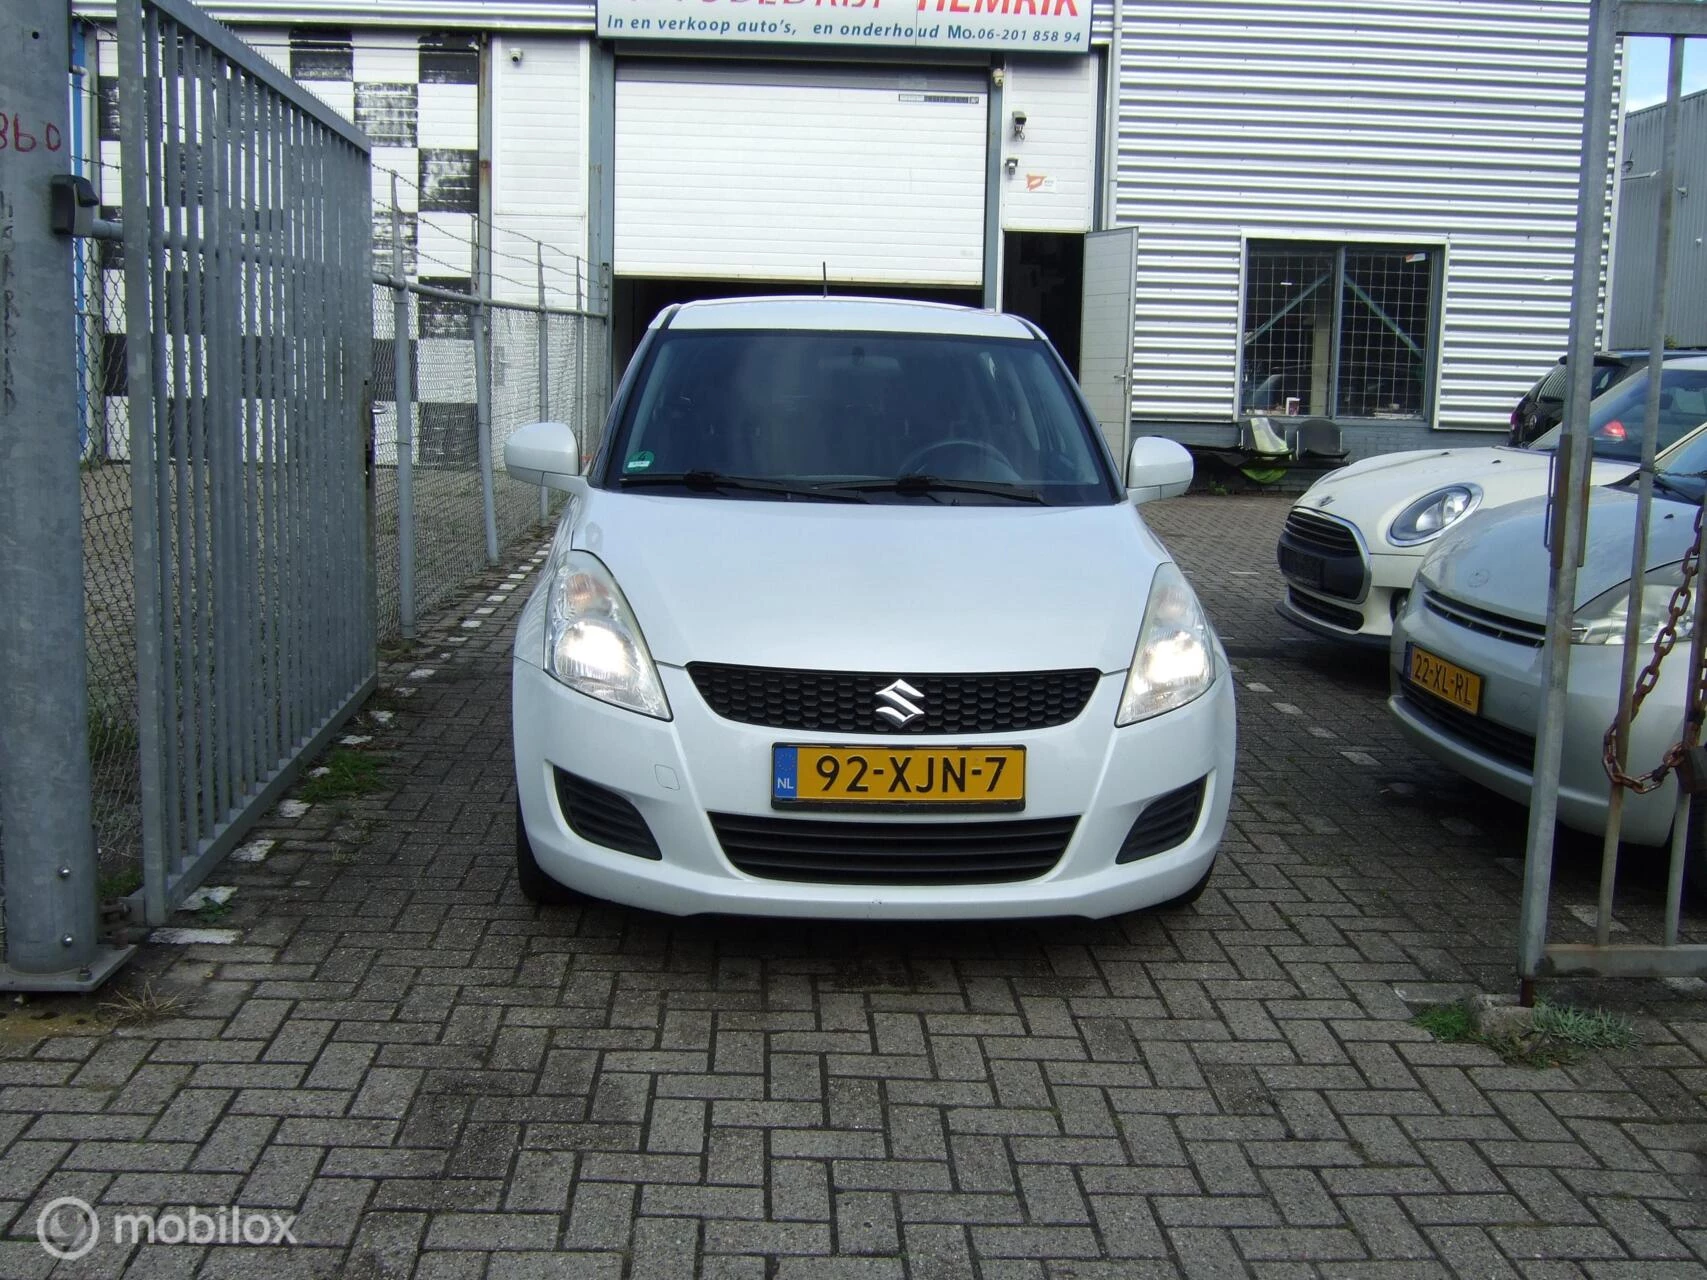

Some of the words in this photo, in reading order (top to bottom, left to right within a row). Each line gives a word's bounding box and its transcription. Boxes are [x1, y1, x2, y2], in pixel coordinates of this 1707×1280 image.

[607, 15, 624, 29] In
[630, 17, 651, 29] en
[658, 16, 731, 35] verkoop
[737, 19, 798, 36] auto's,
[813, 23, 833, 35] en
[840, 22, 940, 39] onderhoud
[1032, 29, 1059, 42] 858
[1063, 31, 1082, 43] 94
[776, 777, 795, 790] NL
[815, 755, 1008, 793] 92-XJN-7
